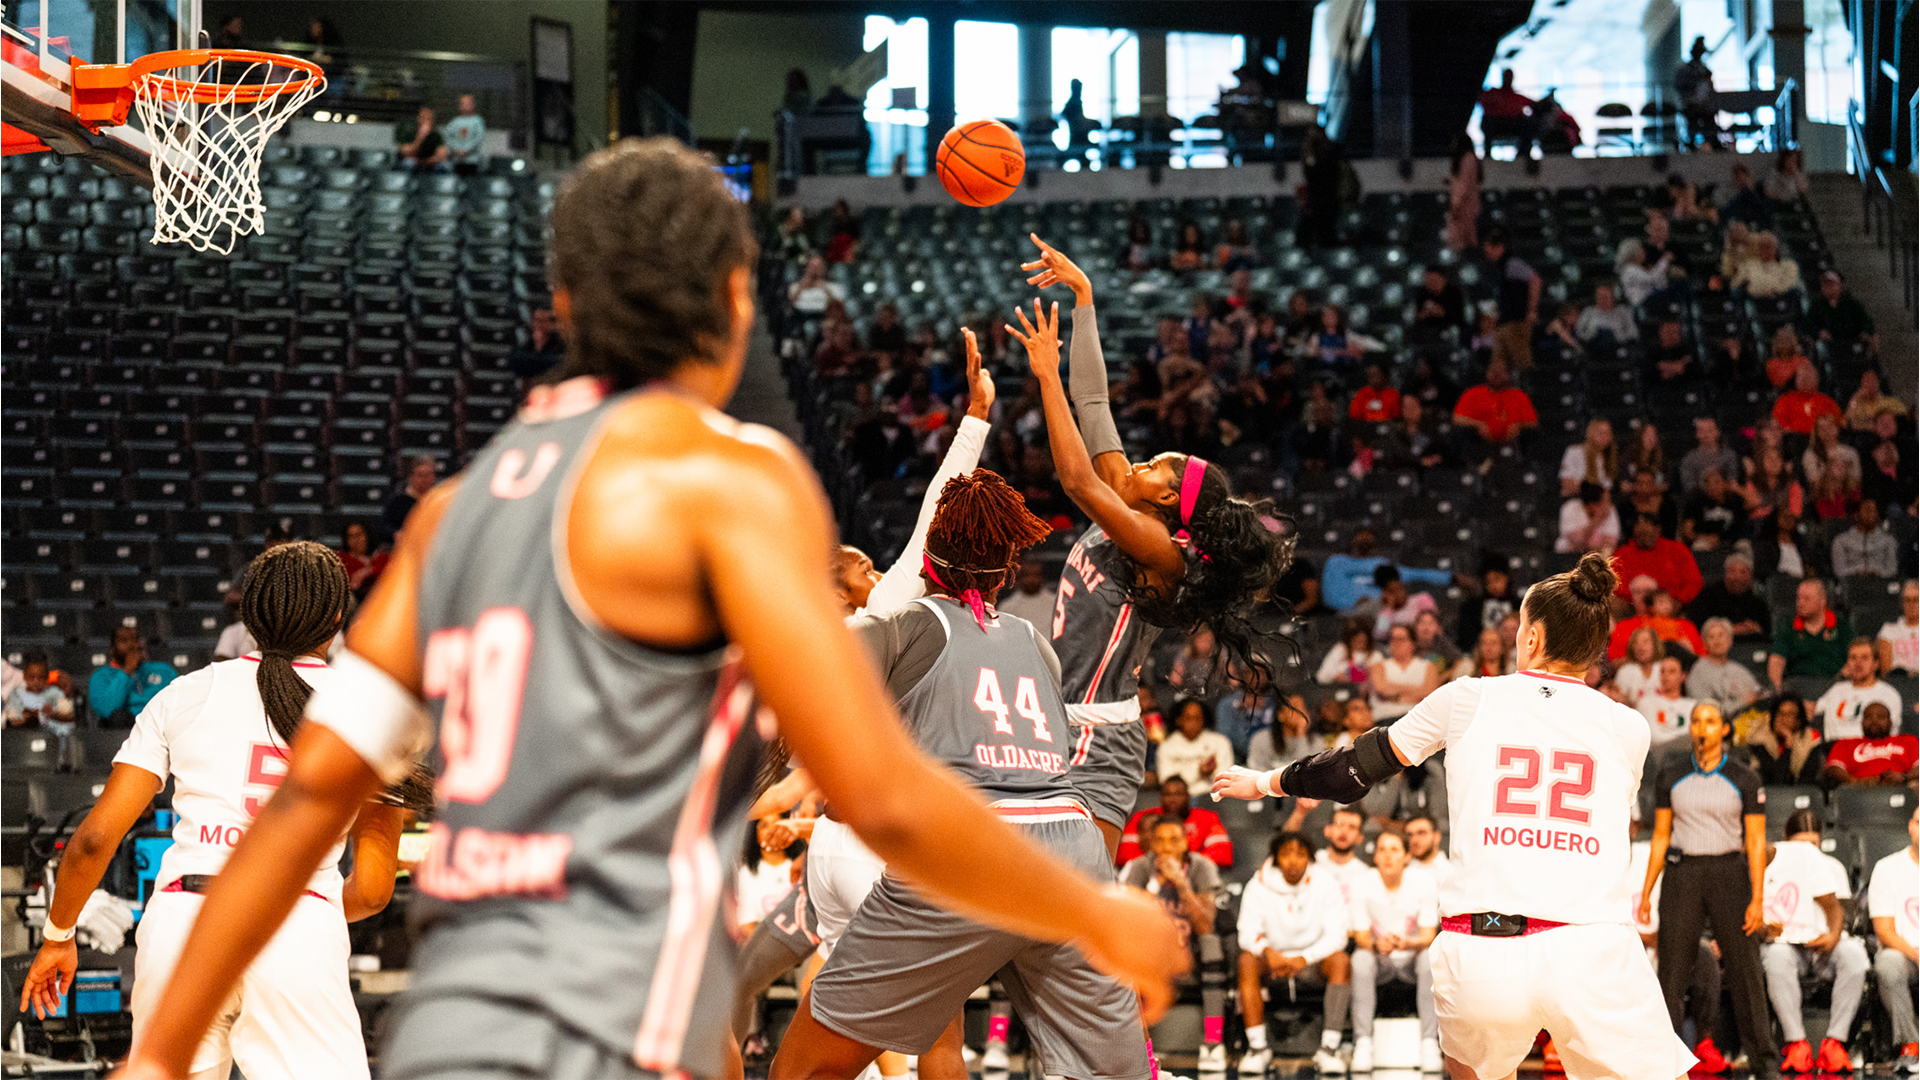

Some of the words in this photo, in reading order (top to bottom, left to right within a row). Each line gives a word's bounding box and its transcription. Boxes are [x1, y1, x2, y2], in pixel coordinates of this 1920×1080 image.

[972, 666, 1054, 744] 44
[975, 744, 1067, 775] OLDACRE
[1491, 743, 1599, 828] 22
[1483, 826, 1600, 856] NOGUERO
